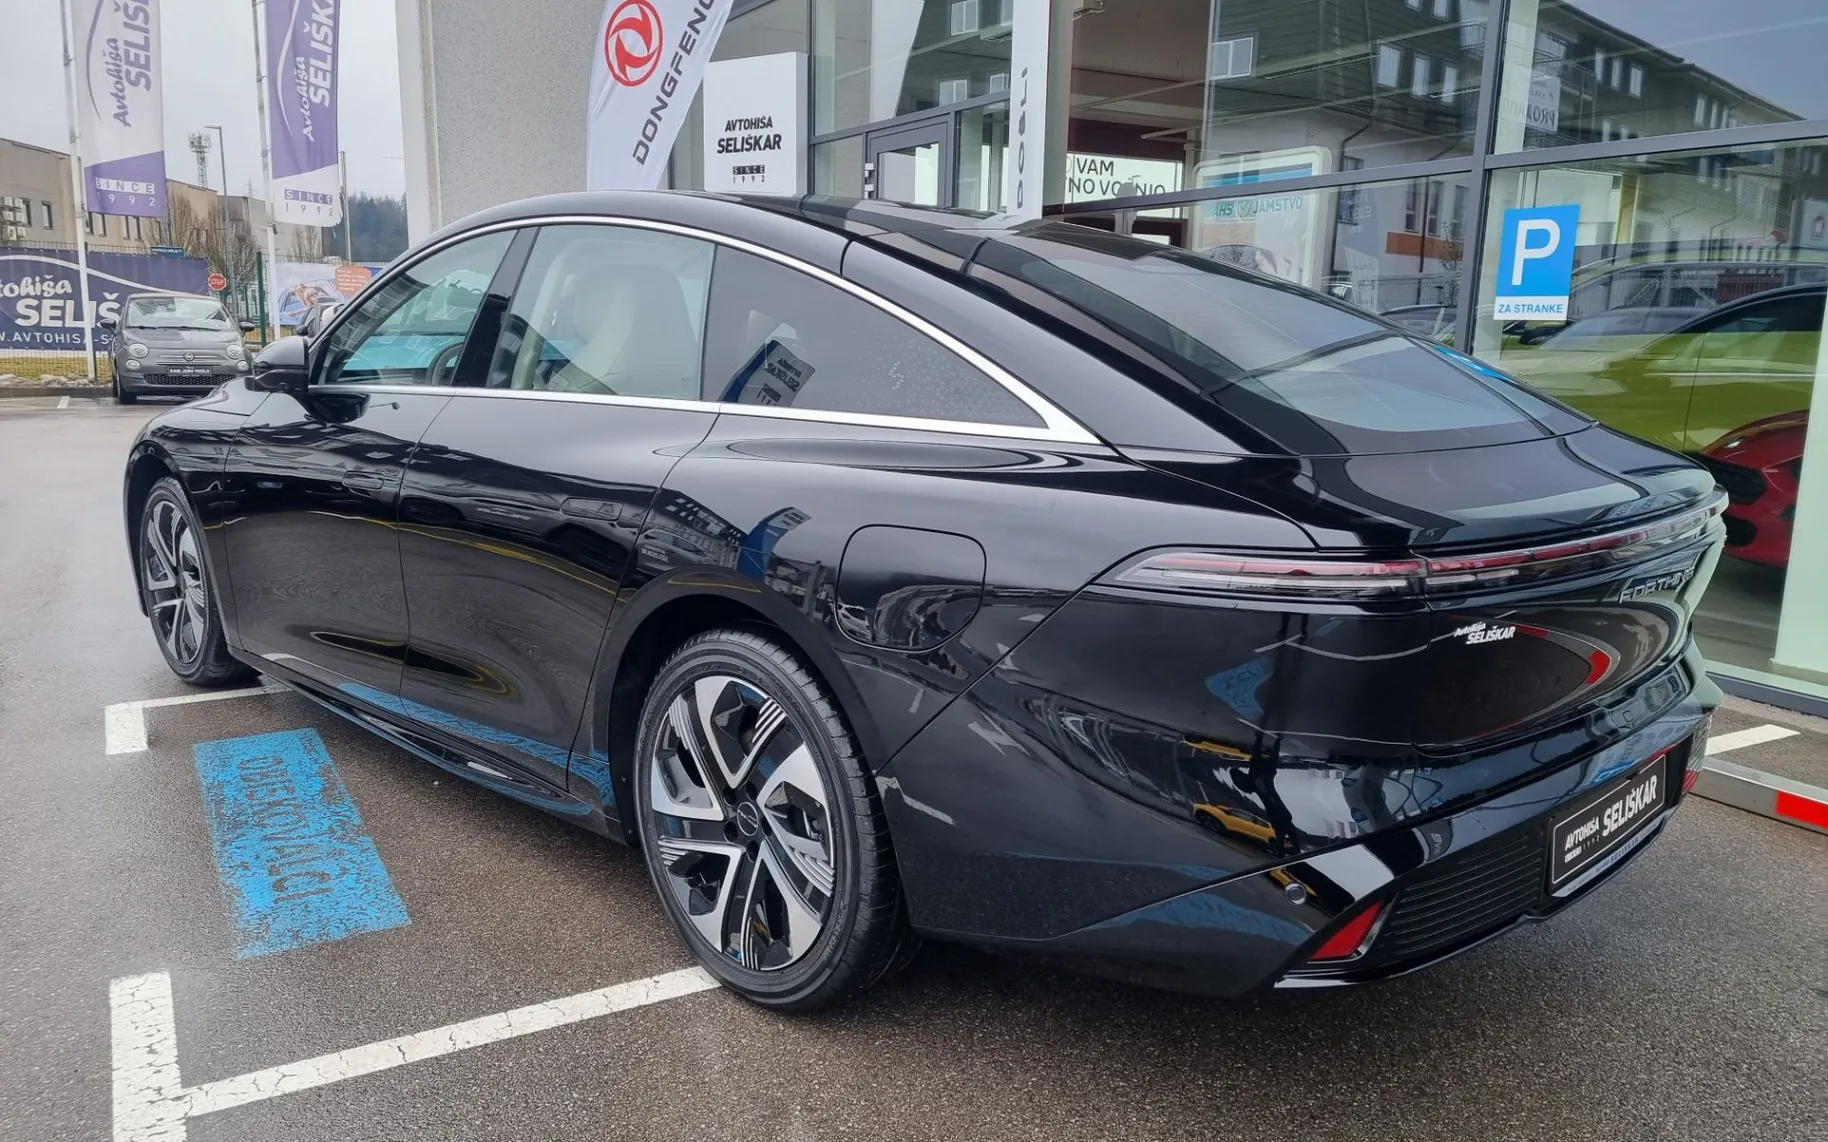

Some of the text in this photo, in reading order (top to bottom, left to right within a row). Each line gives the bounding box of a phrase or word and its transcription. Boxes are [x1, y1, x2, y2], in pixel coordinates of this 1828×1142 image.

[113, 0, 151, 91] SELIŠ
[102, 38, 131, 128] Avtohiša
[293, 57, 314, 141] Avtohiša
[725, 115, 773, 132] AVTOHIŠA
[717, 133, 782, 154] SELIŠKAR
[733, 165, 765, 175] SINCE
[1076, 157, 1114, 176] VAM
[96, 178, 154, 194] SINCE
[1066, 178, 1095, 195] NO
[285, 190, 332, 205] SINCE
[1212, 196, 1304, 217] AHS JAMSTVO
[1512, 218, 1560, 286] P
[1498, 304, 1563, 313] ZA STRANKE
[1465, 625, 1516, 645] SELIŠKAR
[1565, 775, 1658, 851] AVTOHIŠA SELIŠKAR
